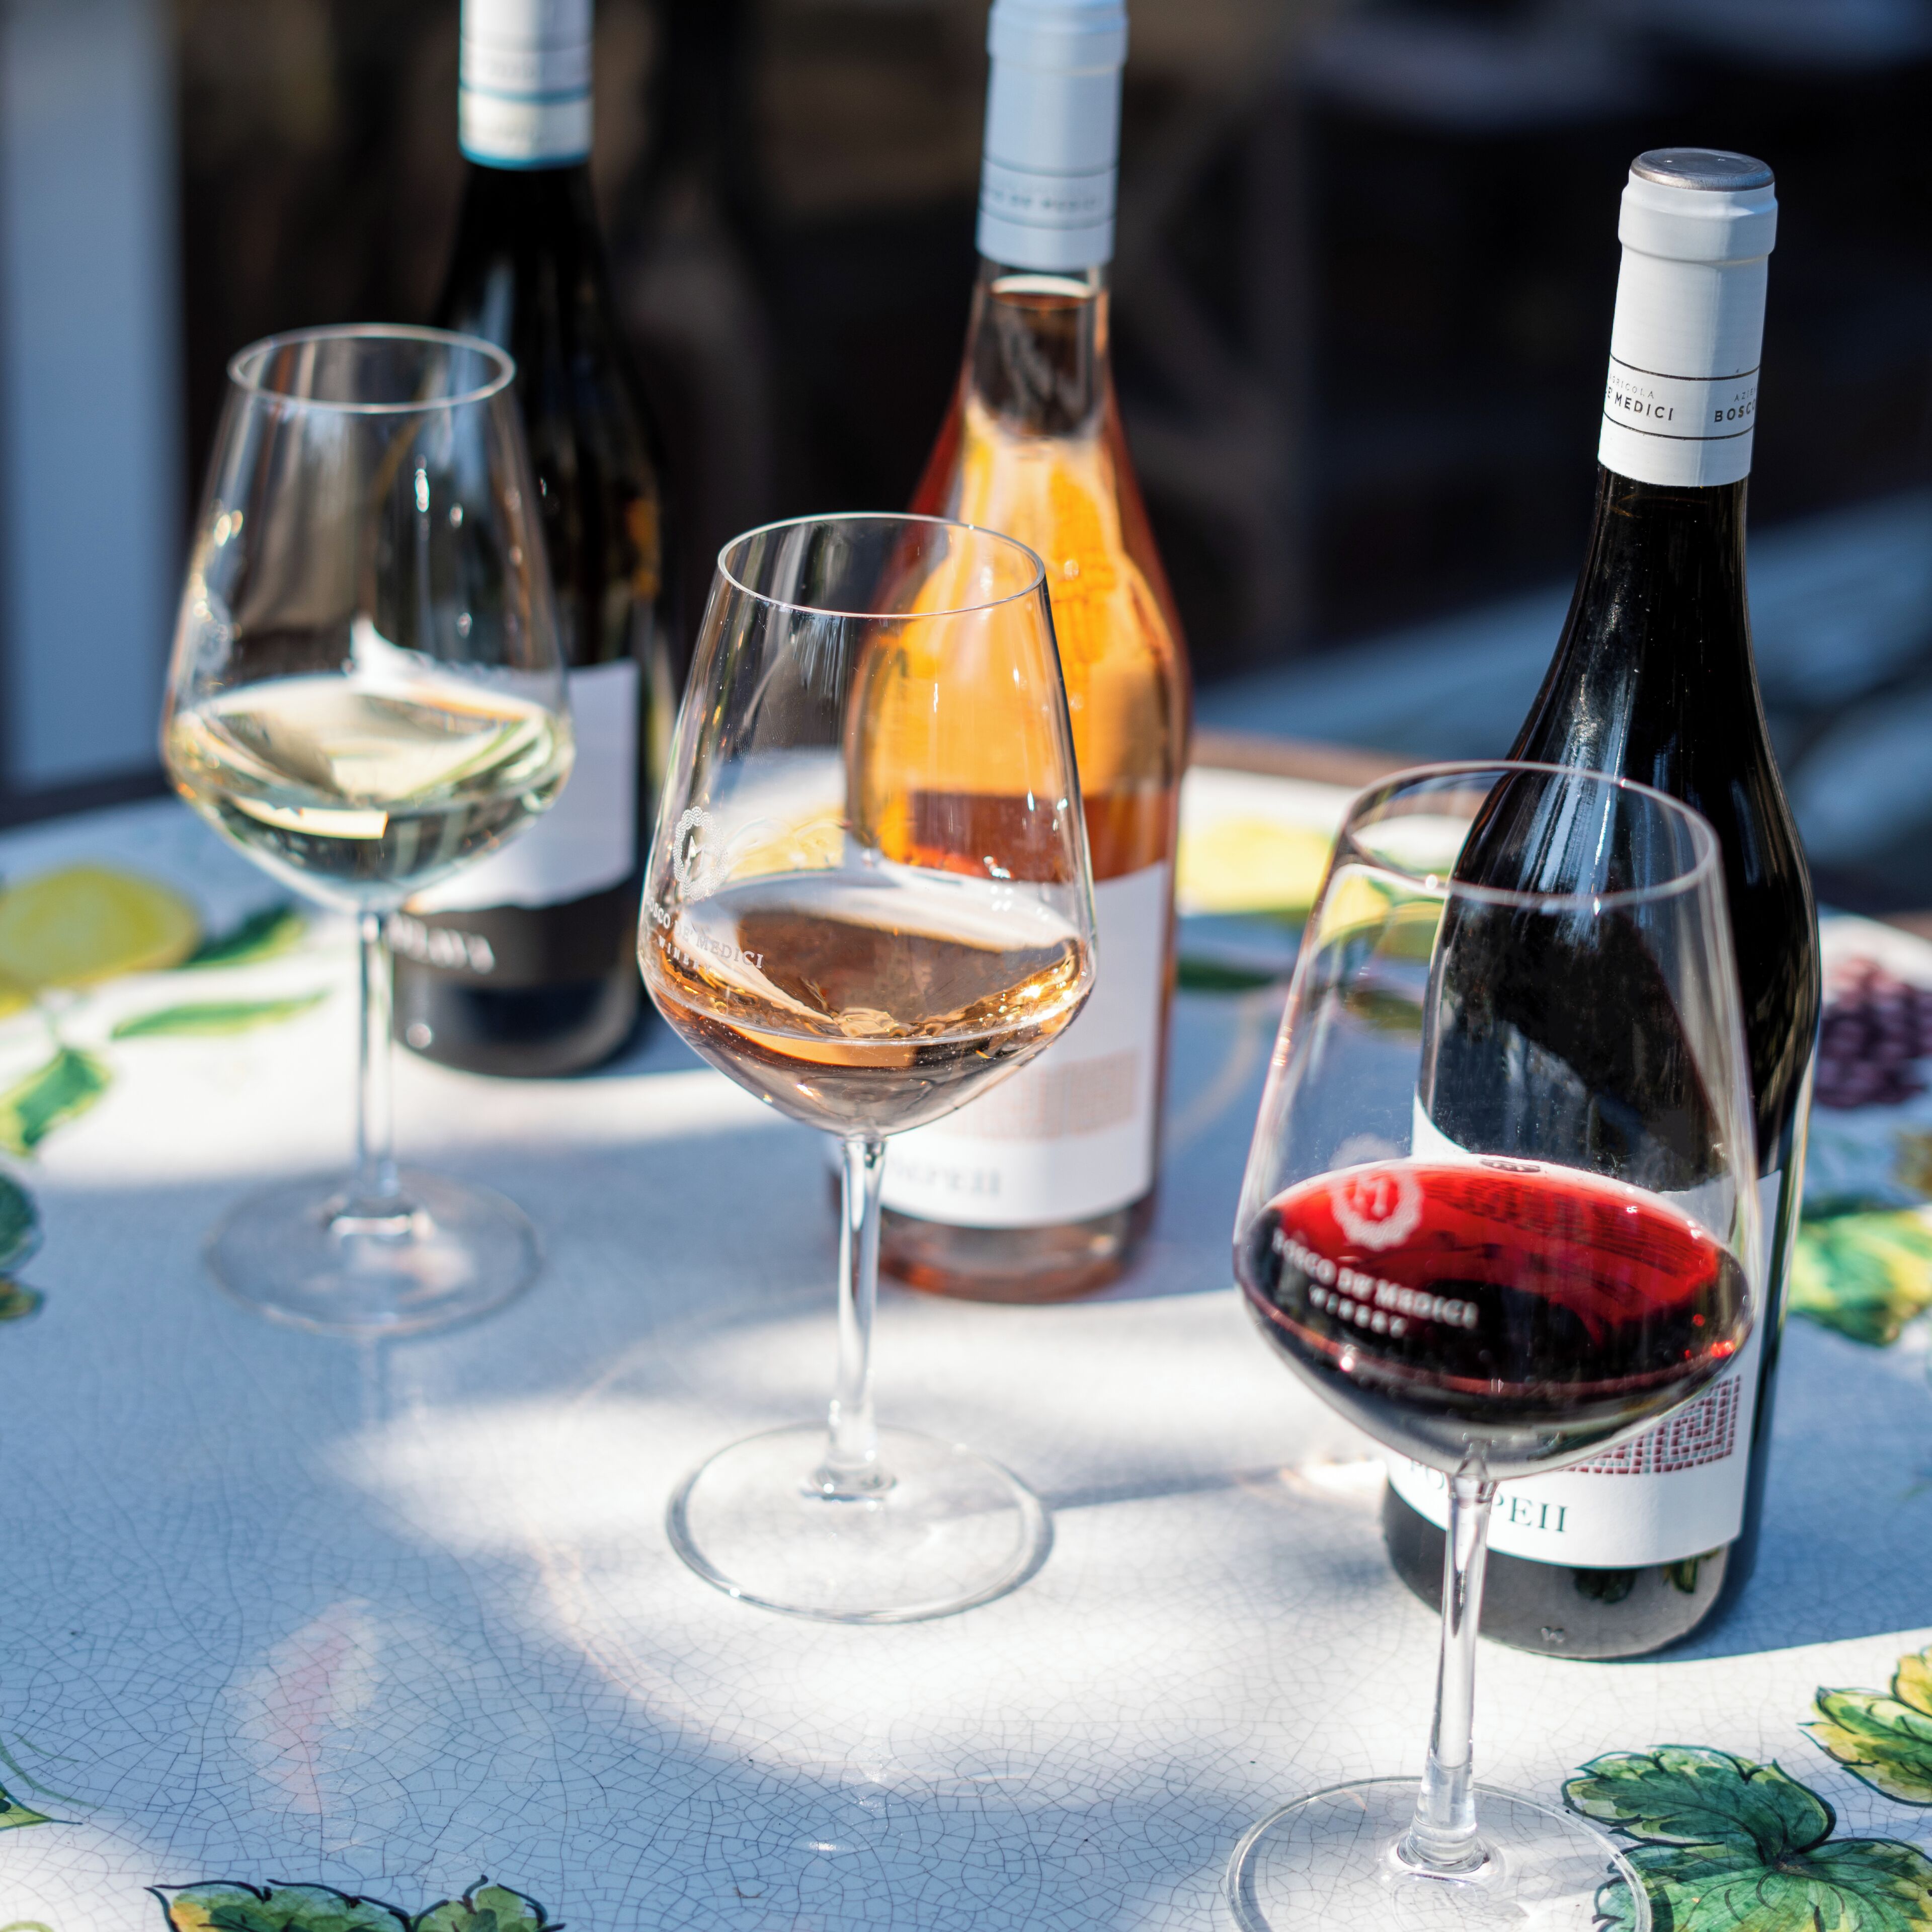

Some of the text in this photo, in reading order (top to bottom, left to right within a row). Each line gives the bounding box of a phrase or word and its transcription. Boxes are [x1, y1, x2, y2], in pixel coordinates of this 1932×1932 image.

[1615, 391, 1674, 421] MEDICI
[1714, 398, 1756, 423] BOSCO
[648, 896, 671, 929] OSCO
[697, 933, 764, 969] MEDICI
[659, 934, 710, 975] WINERY
[1273, 1228, 1338, 1286] BOSCO
[1375, 1278, 1479, 1330] MEDICI
[1309, 1284, 1407, 1339] WINERY
